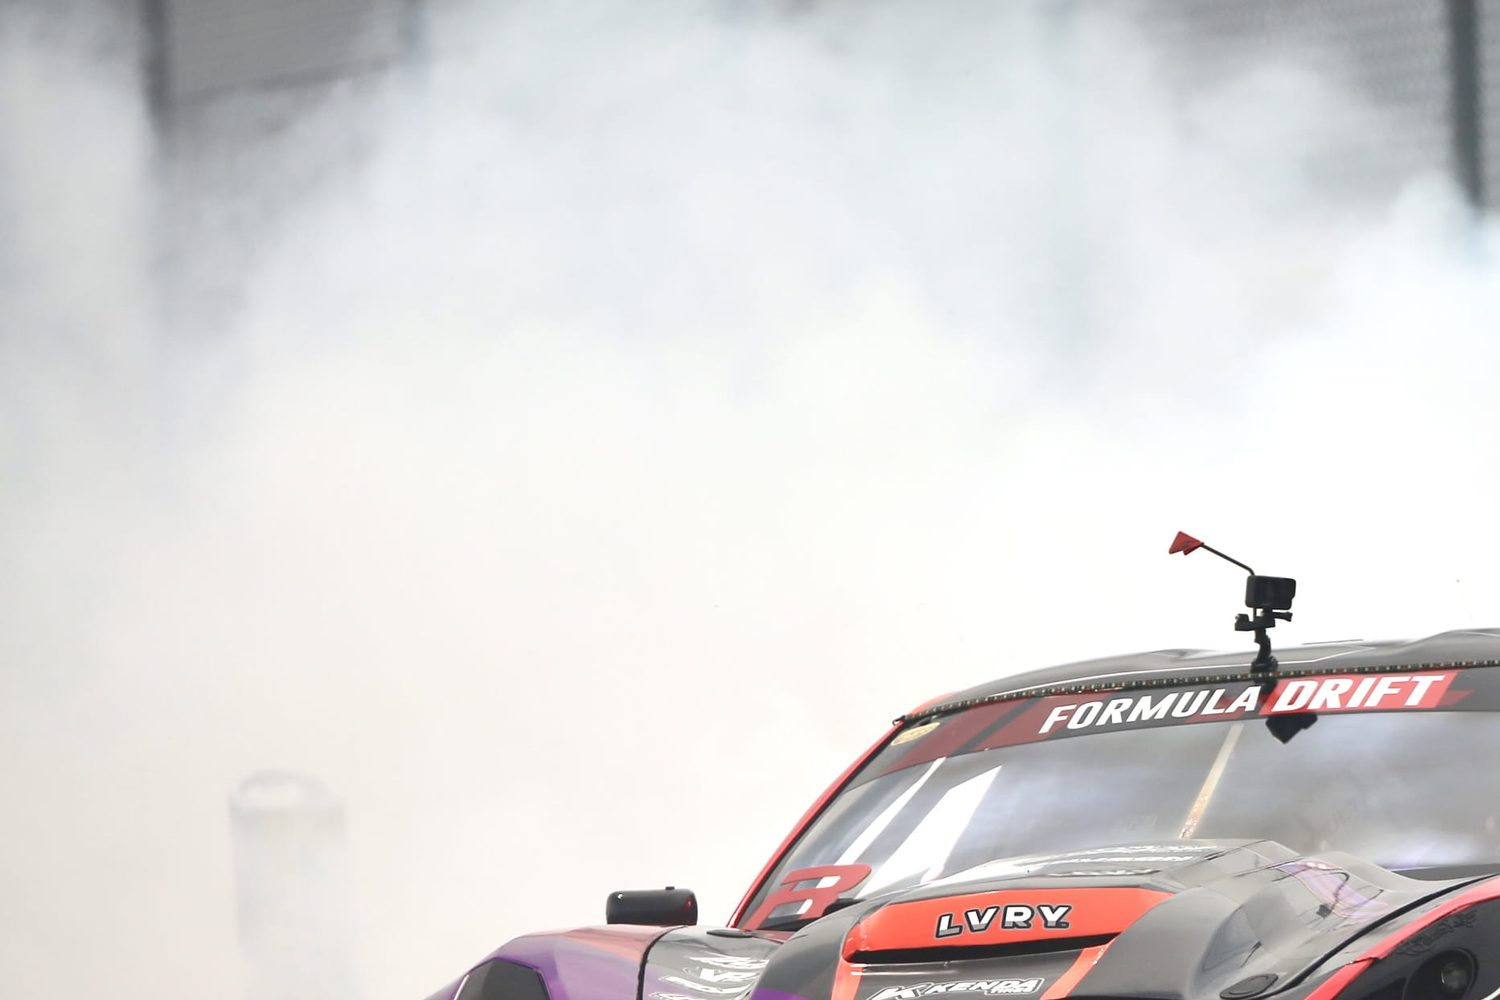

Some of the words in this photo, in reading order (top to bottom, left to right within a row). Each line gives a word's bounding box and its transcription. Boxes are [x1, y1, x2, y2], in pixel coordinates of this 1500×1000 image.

[1039, 686, 1262, 735] FORMULA
[1271, 675, 1445, 712] DRIFT
[924, 979, 1038, 994] KENDA
